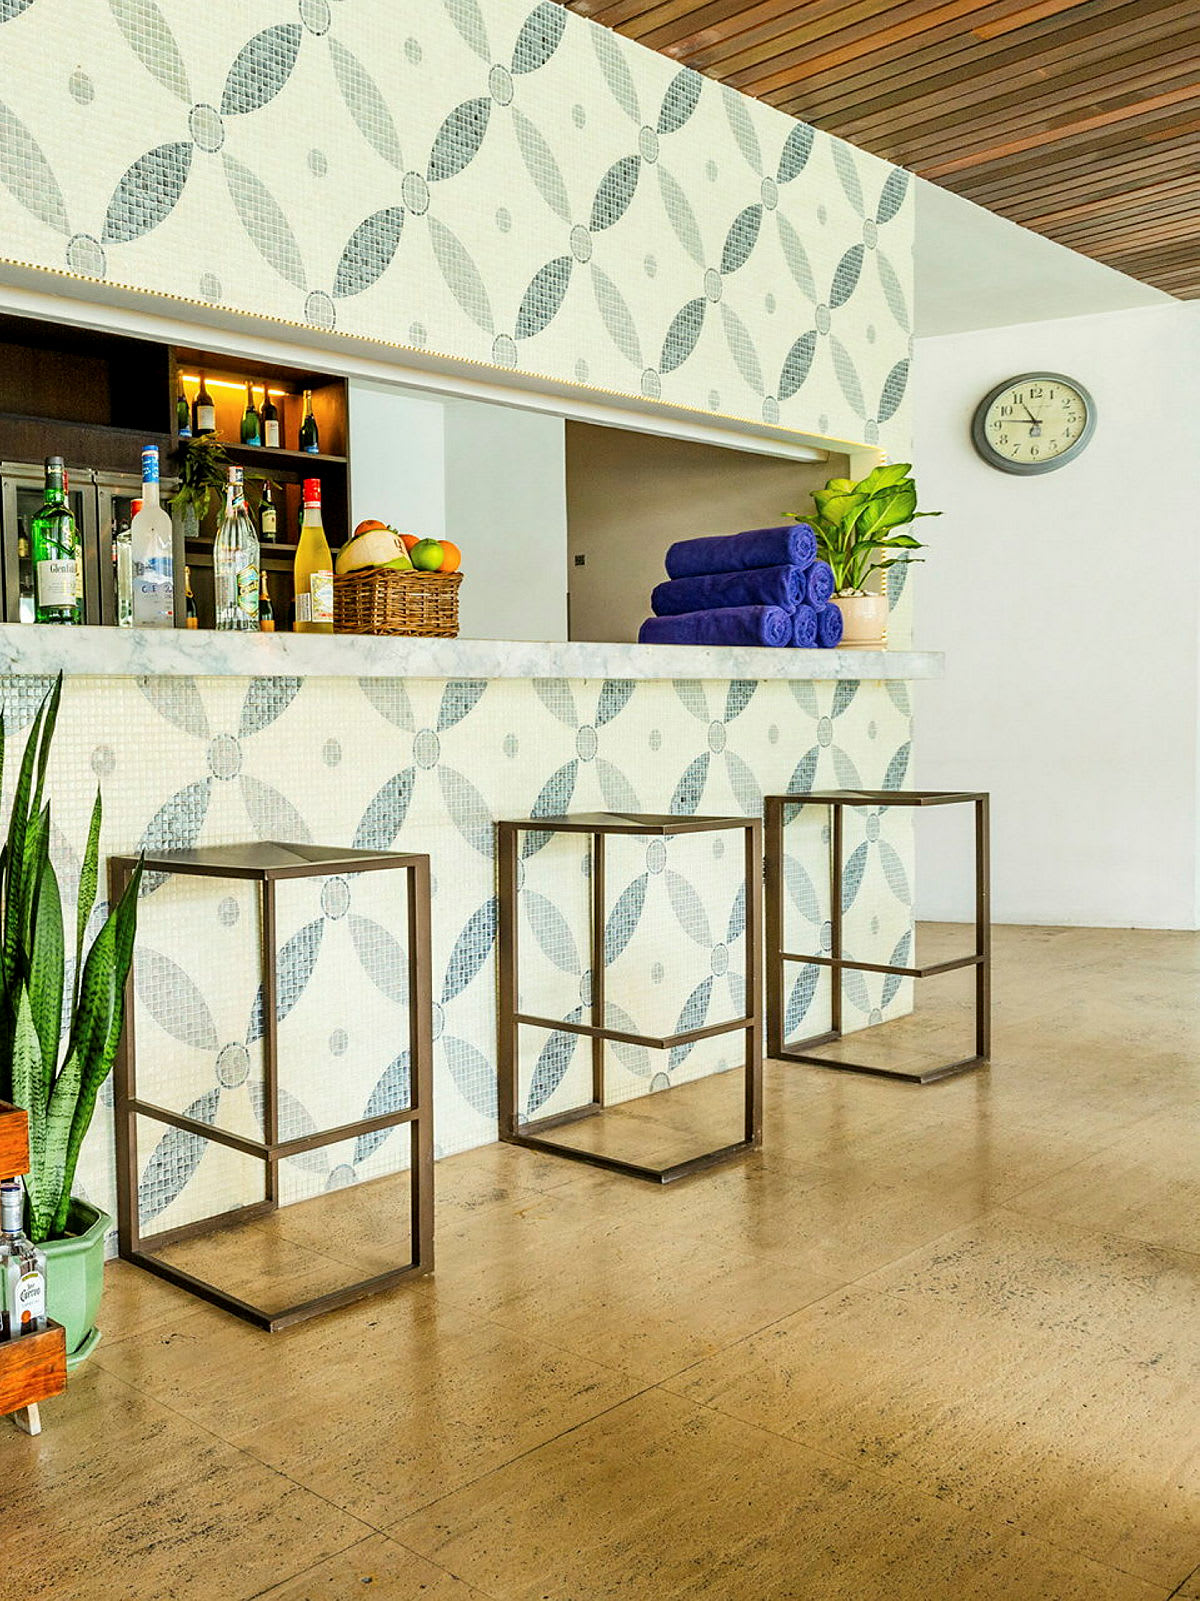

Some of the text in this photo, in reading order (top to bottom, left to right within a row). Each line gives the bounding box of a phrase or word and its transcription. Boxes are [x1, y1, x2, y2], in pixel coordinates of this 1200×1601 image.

[1013, 393, 1023, 404] 11
[1030, 388, 1043, 399] 12
[1061, 399, 1071, 409] 2
[1000, 405, 1013, 416] 10
[999, 434, 1008, 445] 8
[1011, 443, 1021, 457] 7
[1030, 445, 1039, 456] 6
